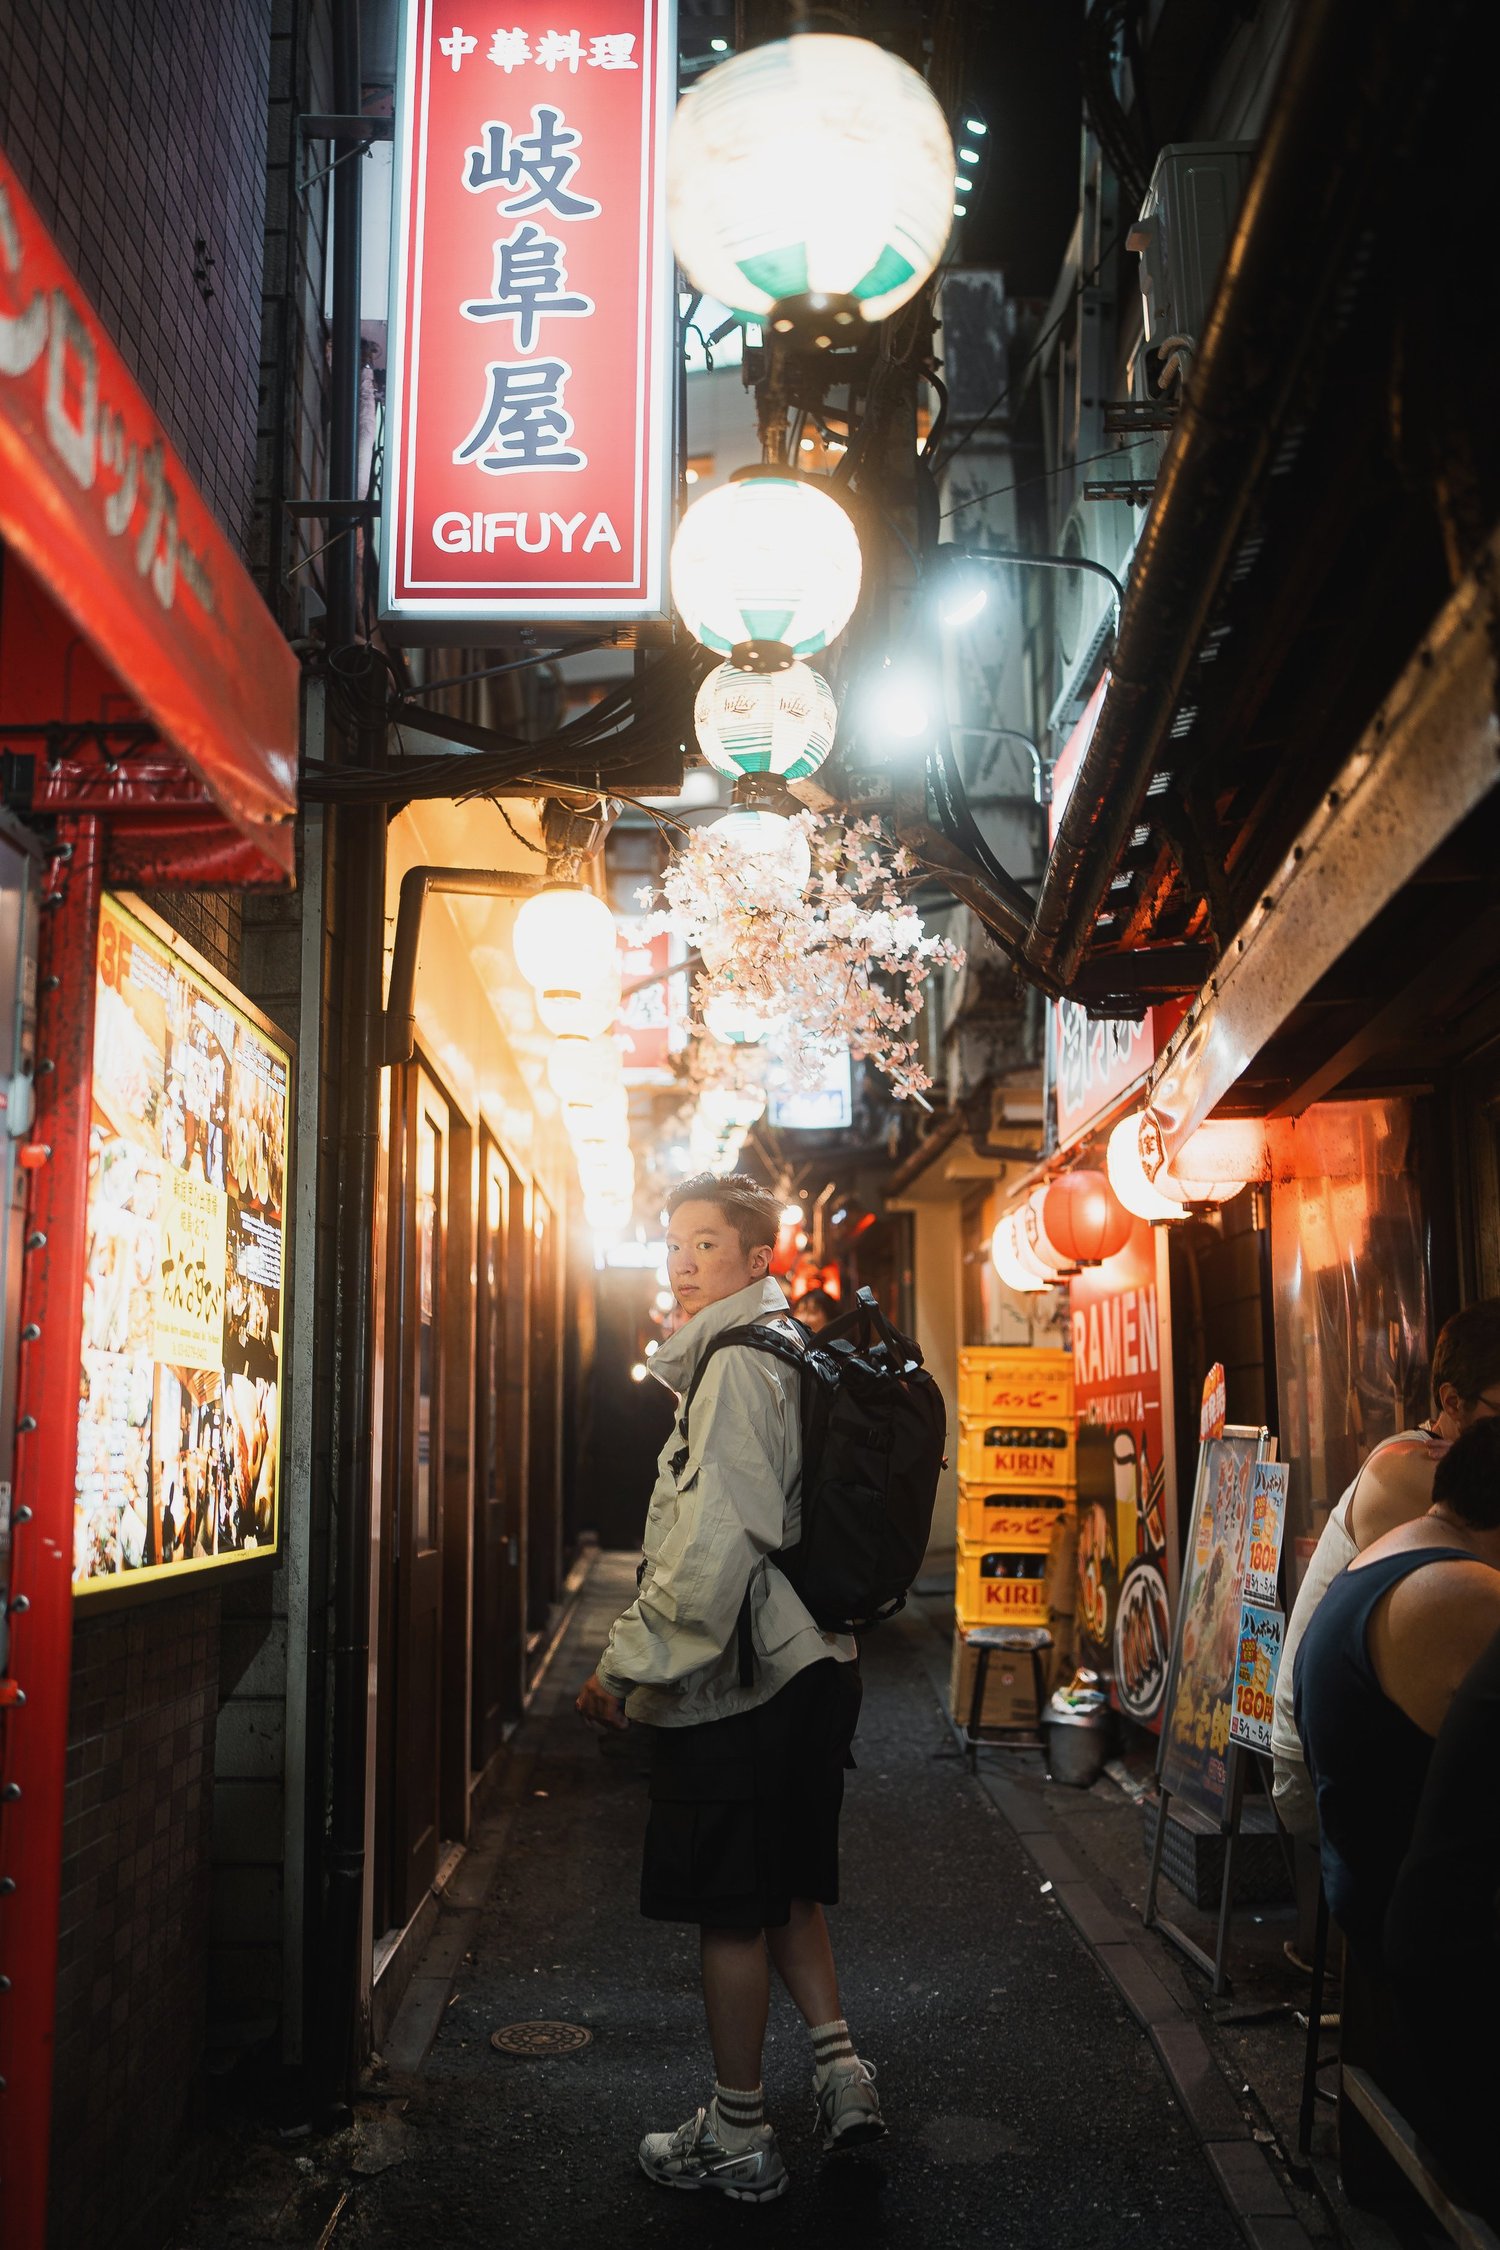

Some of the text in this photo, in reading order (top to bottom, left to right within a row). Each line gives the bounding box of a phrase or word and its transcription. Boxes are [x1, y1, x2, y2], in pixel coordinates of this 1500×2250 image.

[438, 27, 639, 73] 中華料理
[454, 104, 602, 476] 岐阜屋
[431, 511, 622, 554] GIFUYA
[101, 921, 133, 996] 3F
[1073, 1282, 1158, 1386] RAMEN
[992, 1389, 1059, 1408] ホッピー
[995, 1453, 1055, 1470] KIRIN
[990, 1517, 1055, 1535] ホッピー
[1250, 1542, 1277, 1574] 180円
[986, 1585, 1047, 1605] KIRI
[1242, 1613, 1281, 1643] ハイボール
[1265, 1643, 1279, 1656] フェア
[1236, 1685, 1273, 1724] 180円
[1258, 1725, 1272, 1748] 5/1
